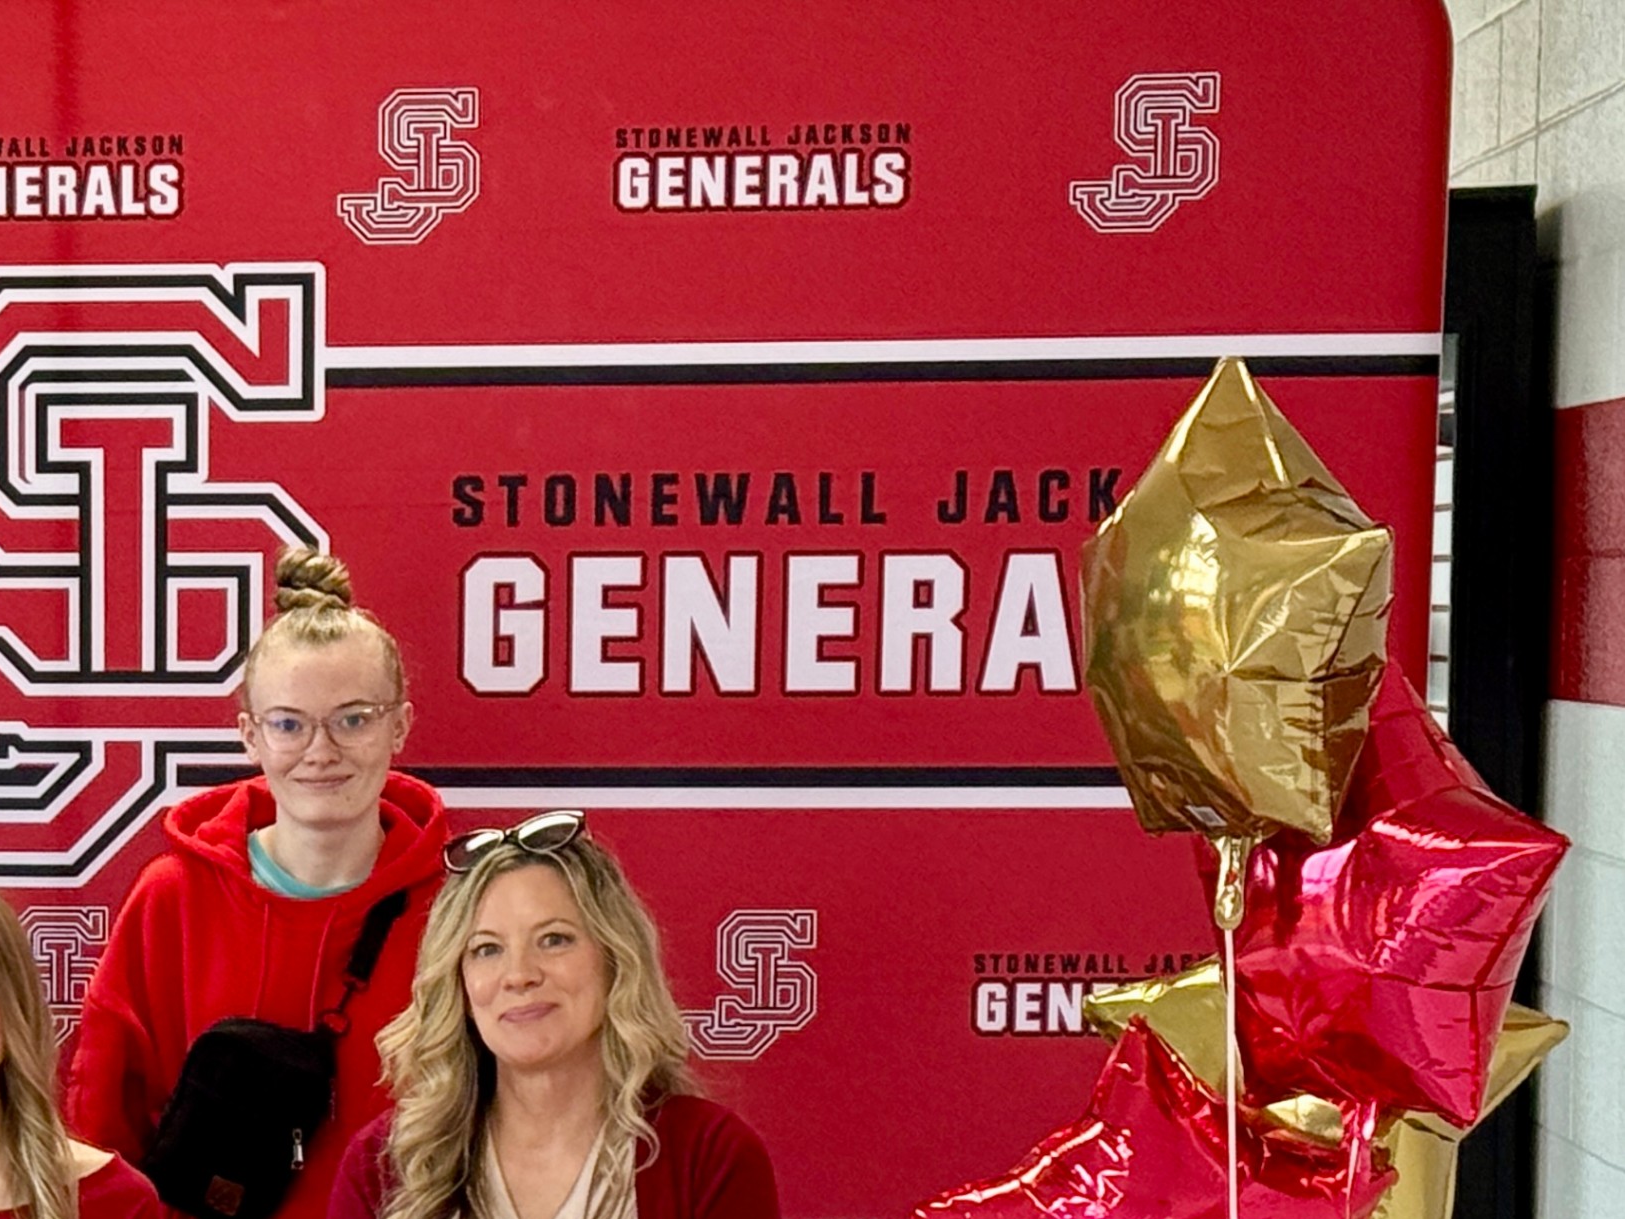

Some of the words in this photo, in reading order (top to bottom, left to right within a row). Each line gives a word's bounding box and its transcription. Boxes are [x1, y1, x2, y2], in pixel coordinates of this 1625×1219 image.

[66, 134, 184, 157] JACKSON
[615, 125, 776, 149] STONEWALL
[786, 122, 912, 147] JACKSON
[615, 152, 909, 212] GENERALS
[451, 471, 888, 528] STONEWALL
[937, 469, 1123, 524] JACK
[460, 550, 1081, 698] GENERA
[974, 953, 1128, 974] STONEWALL
